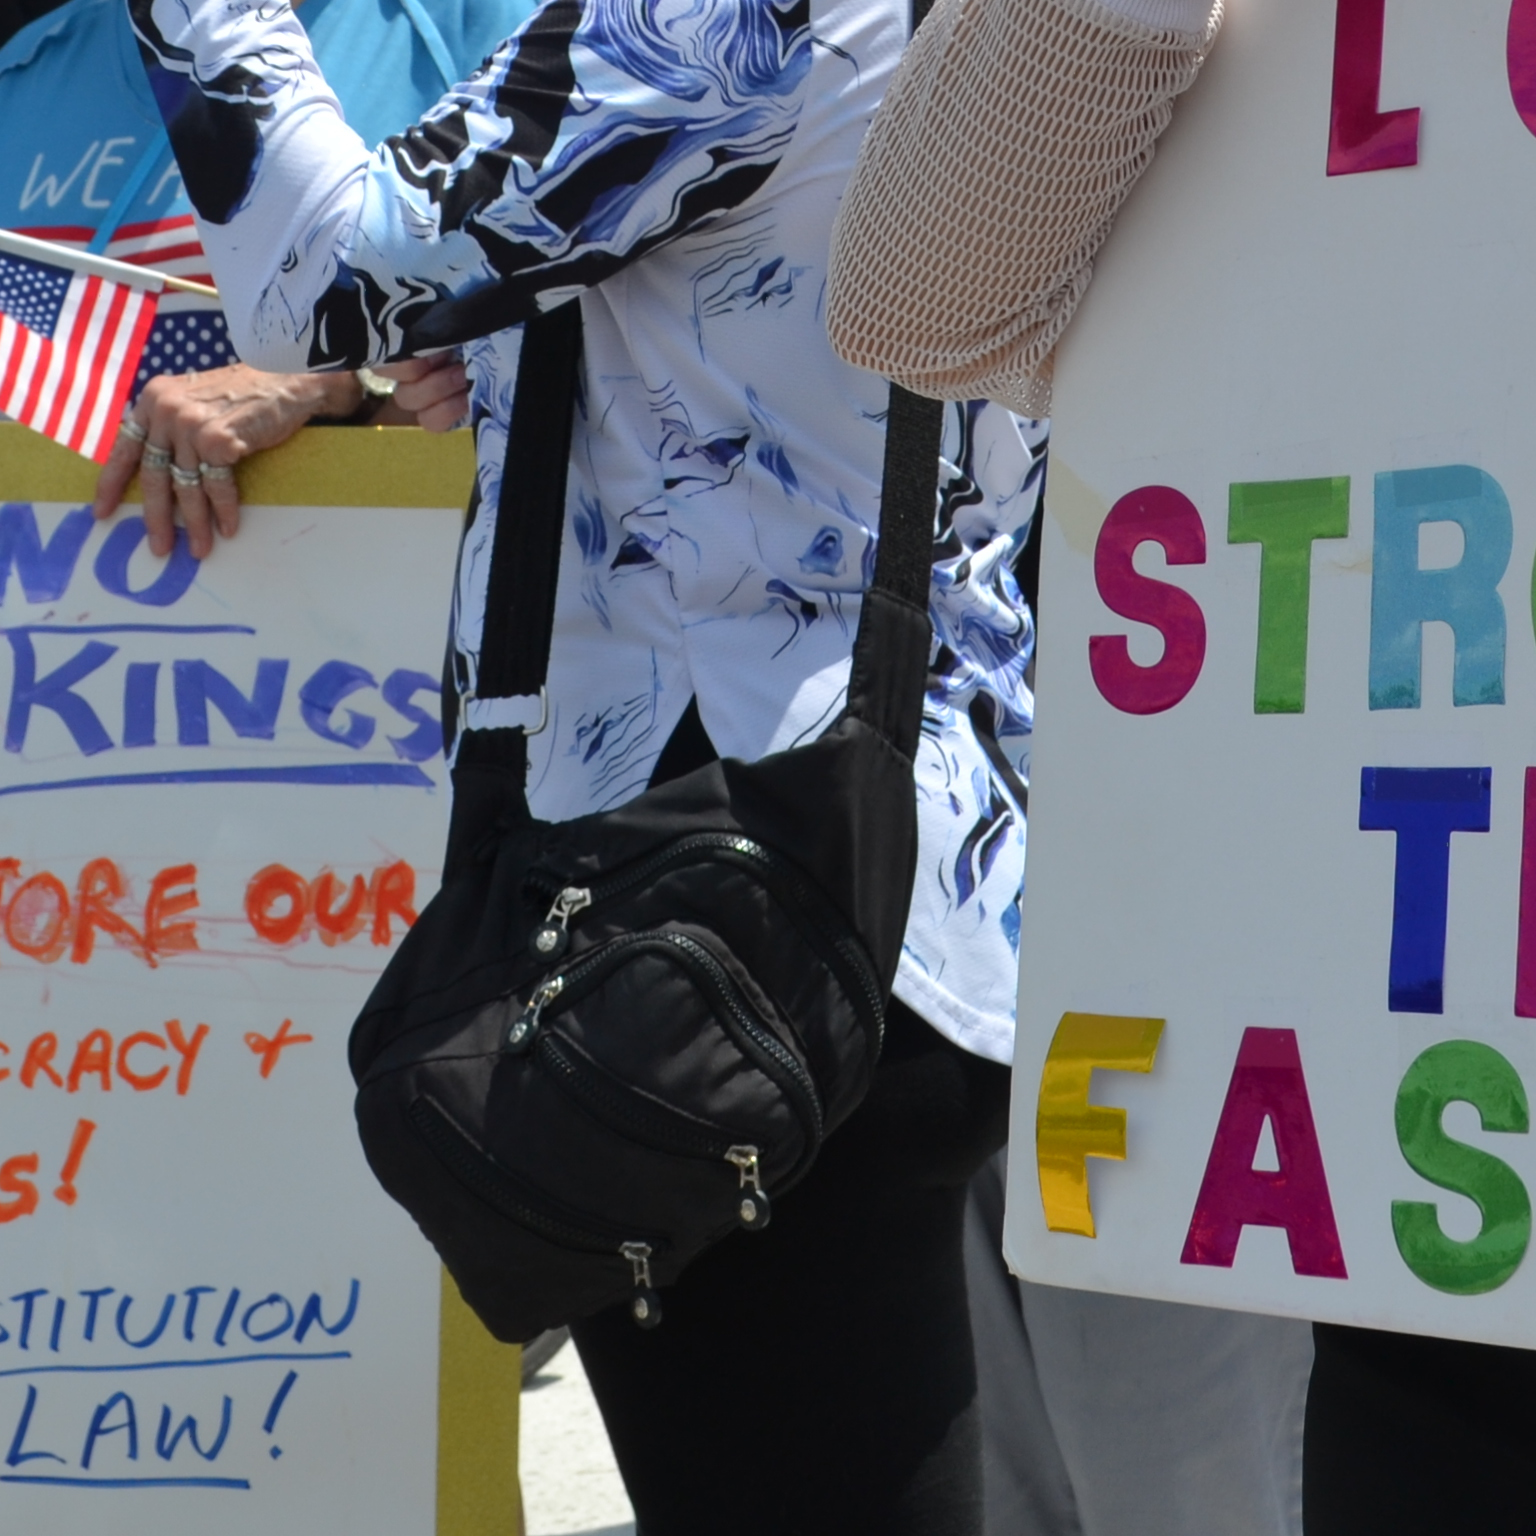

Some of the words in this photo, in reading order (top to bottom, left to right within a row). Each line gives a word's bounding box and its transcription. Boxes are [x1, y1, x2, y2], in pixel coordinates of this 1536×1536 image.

[19, 136, 136, 212] WE
[2, 630, 446, 763] KINGS
[243, 858, 421, 948] OUR
[3, 1370, 298, 1469] LAW!
